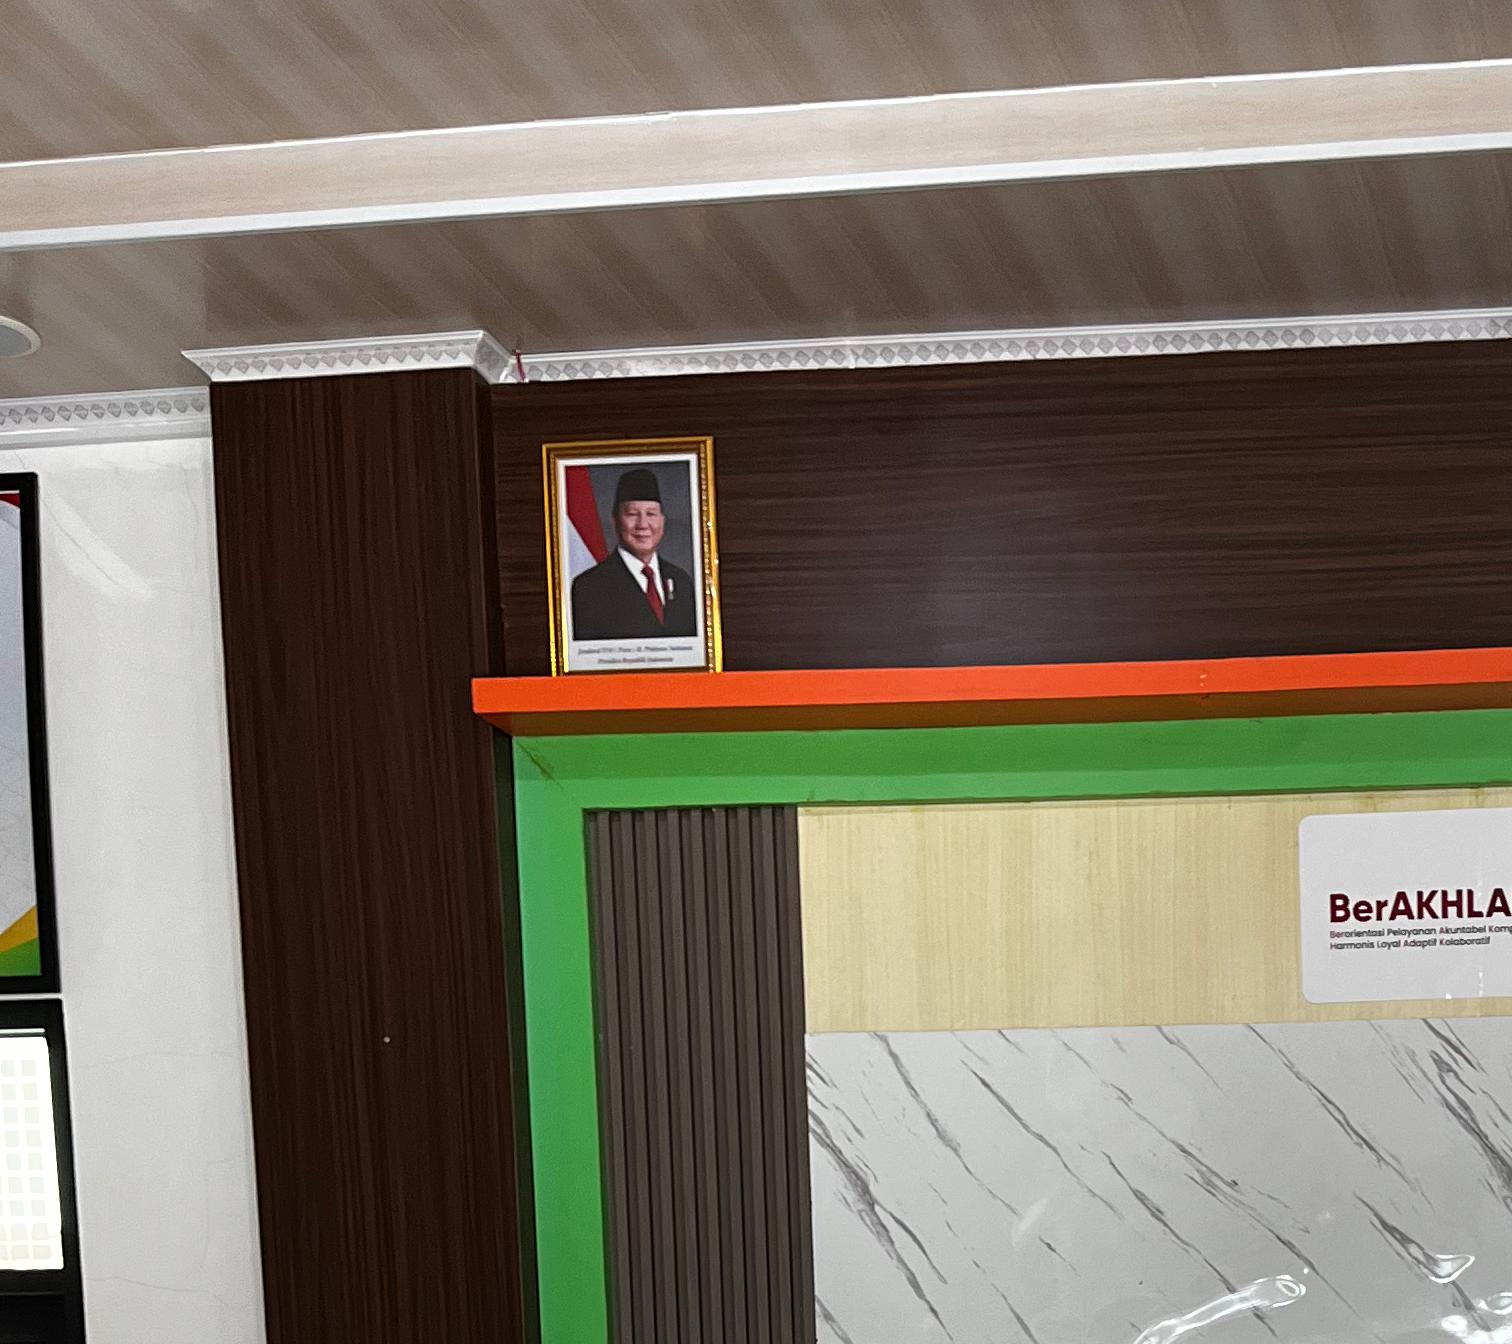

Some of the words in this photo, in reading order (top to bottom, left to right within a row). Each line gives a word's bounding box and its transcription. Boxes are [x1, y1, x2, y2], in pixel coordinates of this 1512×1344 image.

[1329, 928, 1385, 939] Berorientasi
[1386, 927, 1437, 938] Pelayanan
[1438, 925, 1487, 935] Akuntabel
[1376, 940, 1400, 950] Loyal
[1402, 938, 1438, 949] Adaptif
